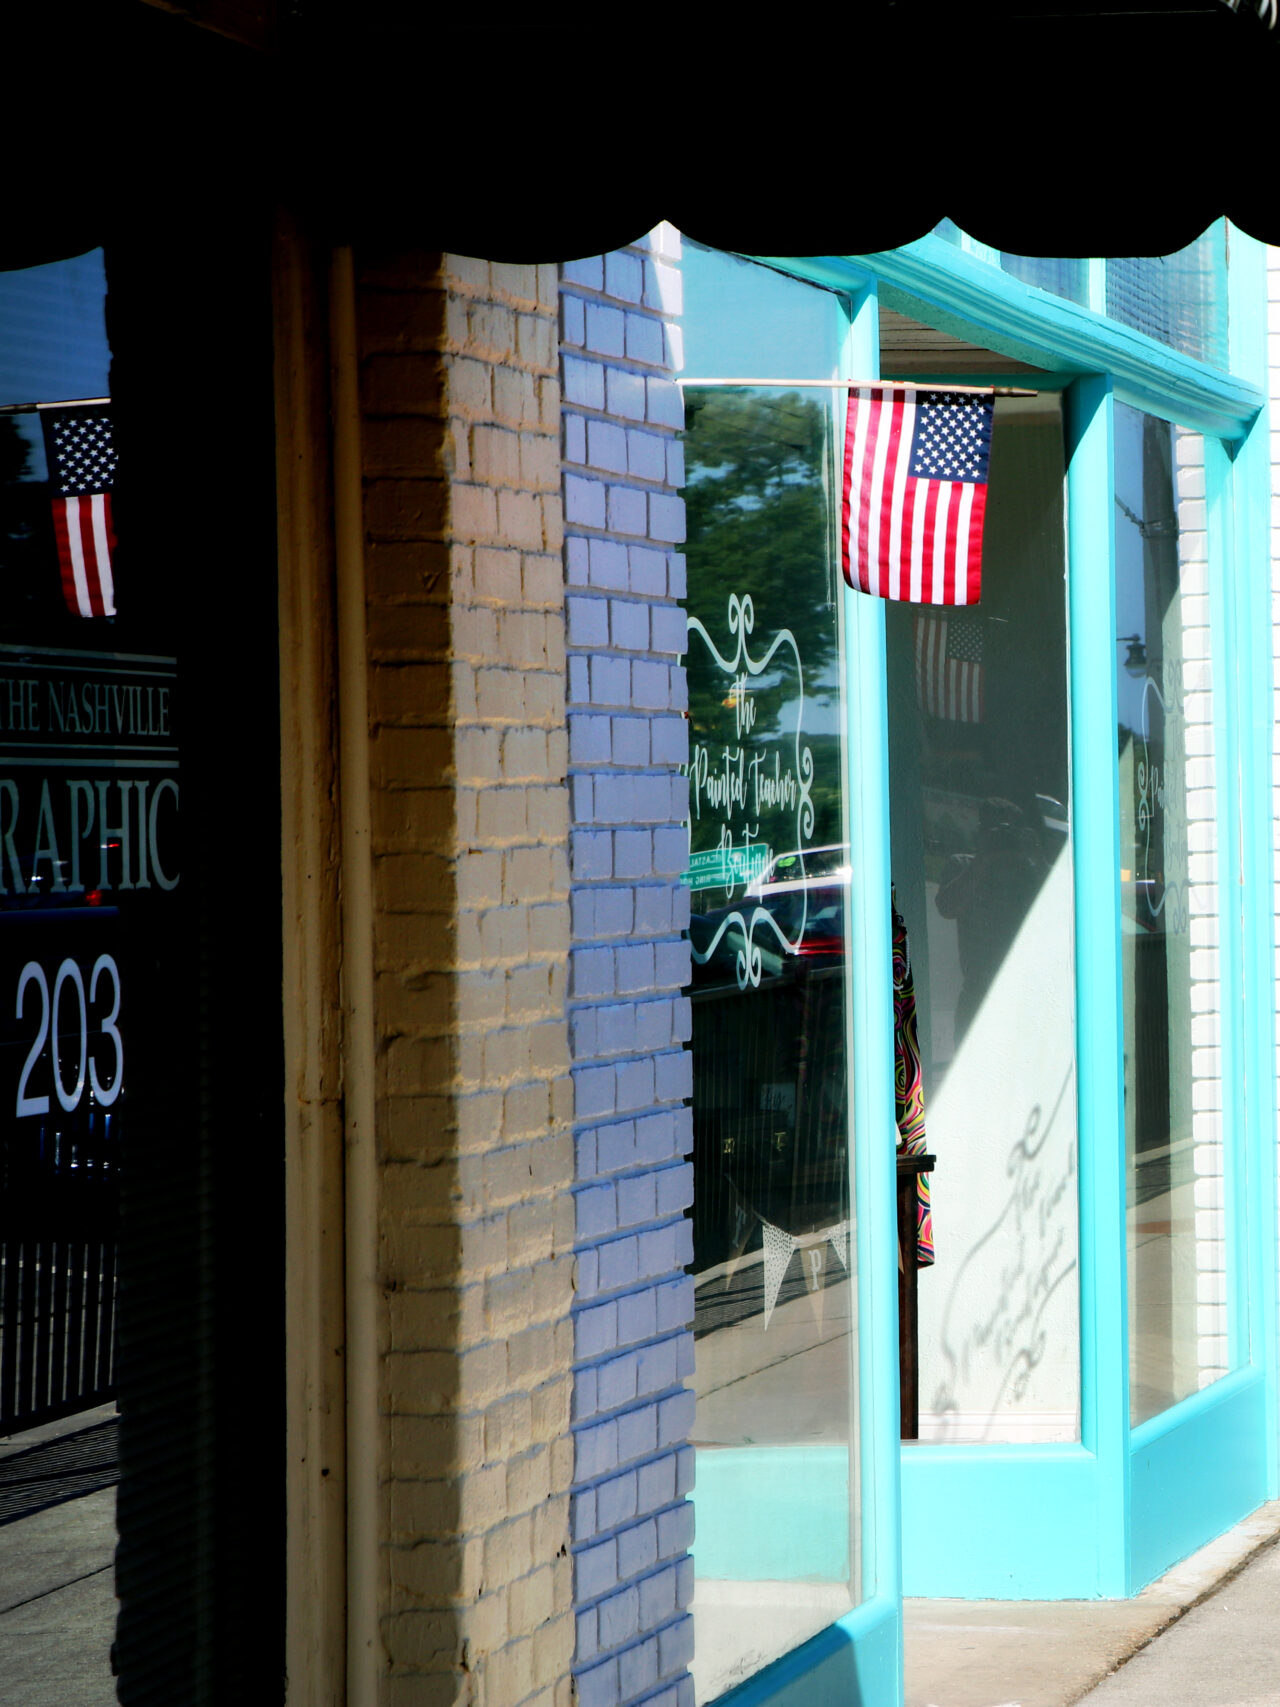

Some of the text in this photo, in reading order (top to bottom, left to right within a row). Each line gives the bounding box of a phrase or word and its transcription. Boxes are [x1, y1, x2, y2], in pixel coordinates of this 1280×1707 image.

[47, 680, 171, 737] NASHVILLE
[689, 744, 797, 820] Painted Teacher
[0, 778, 180, 896] RAPHIC
[716, 822, 776, 904] Boutique
[15, 953, 125, 1119] 203
